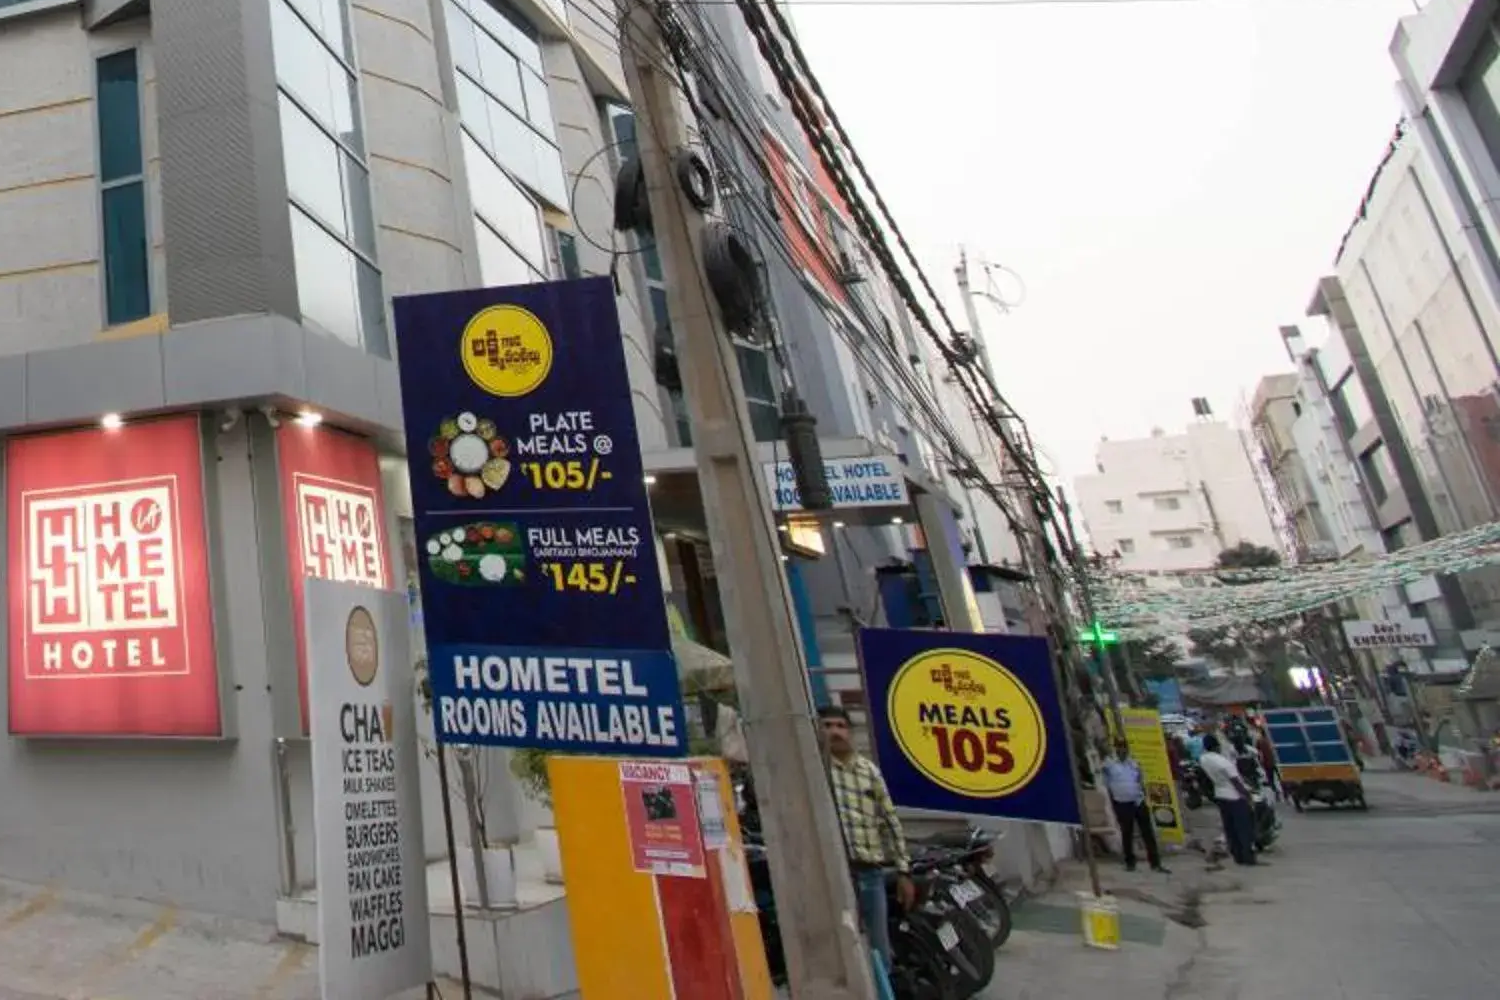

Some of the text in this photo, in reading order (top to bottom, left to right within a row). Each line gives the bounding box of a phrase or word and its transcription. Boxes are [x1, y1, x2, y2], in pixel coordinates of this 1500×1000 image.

[529, 411, 594, 432] PLATE
[516, 433, 613, 455] MEALS @
[843, 461, 891, 478] HOTEL
[527, 526, 640, 546] FULL MEALS
[42, 636, 166, 670] HOTEL
[453, 655, 649, 697] HOMETEL
[439, 696, 679, 747] ROOMS AVAILABLE
[918, 702, 1011, 729] MEALS
[342, 747, 395, 773] ICE TEAS
[346, 821, 399, 849] BURGERS
[350, 890, 404, 922] WAFFLES
[351, 916, 405, 959] MAGGI
